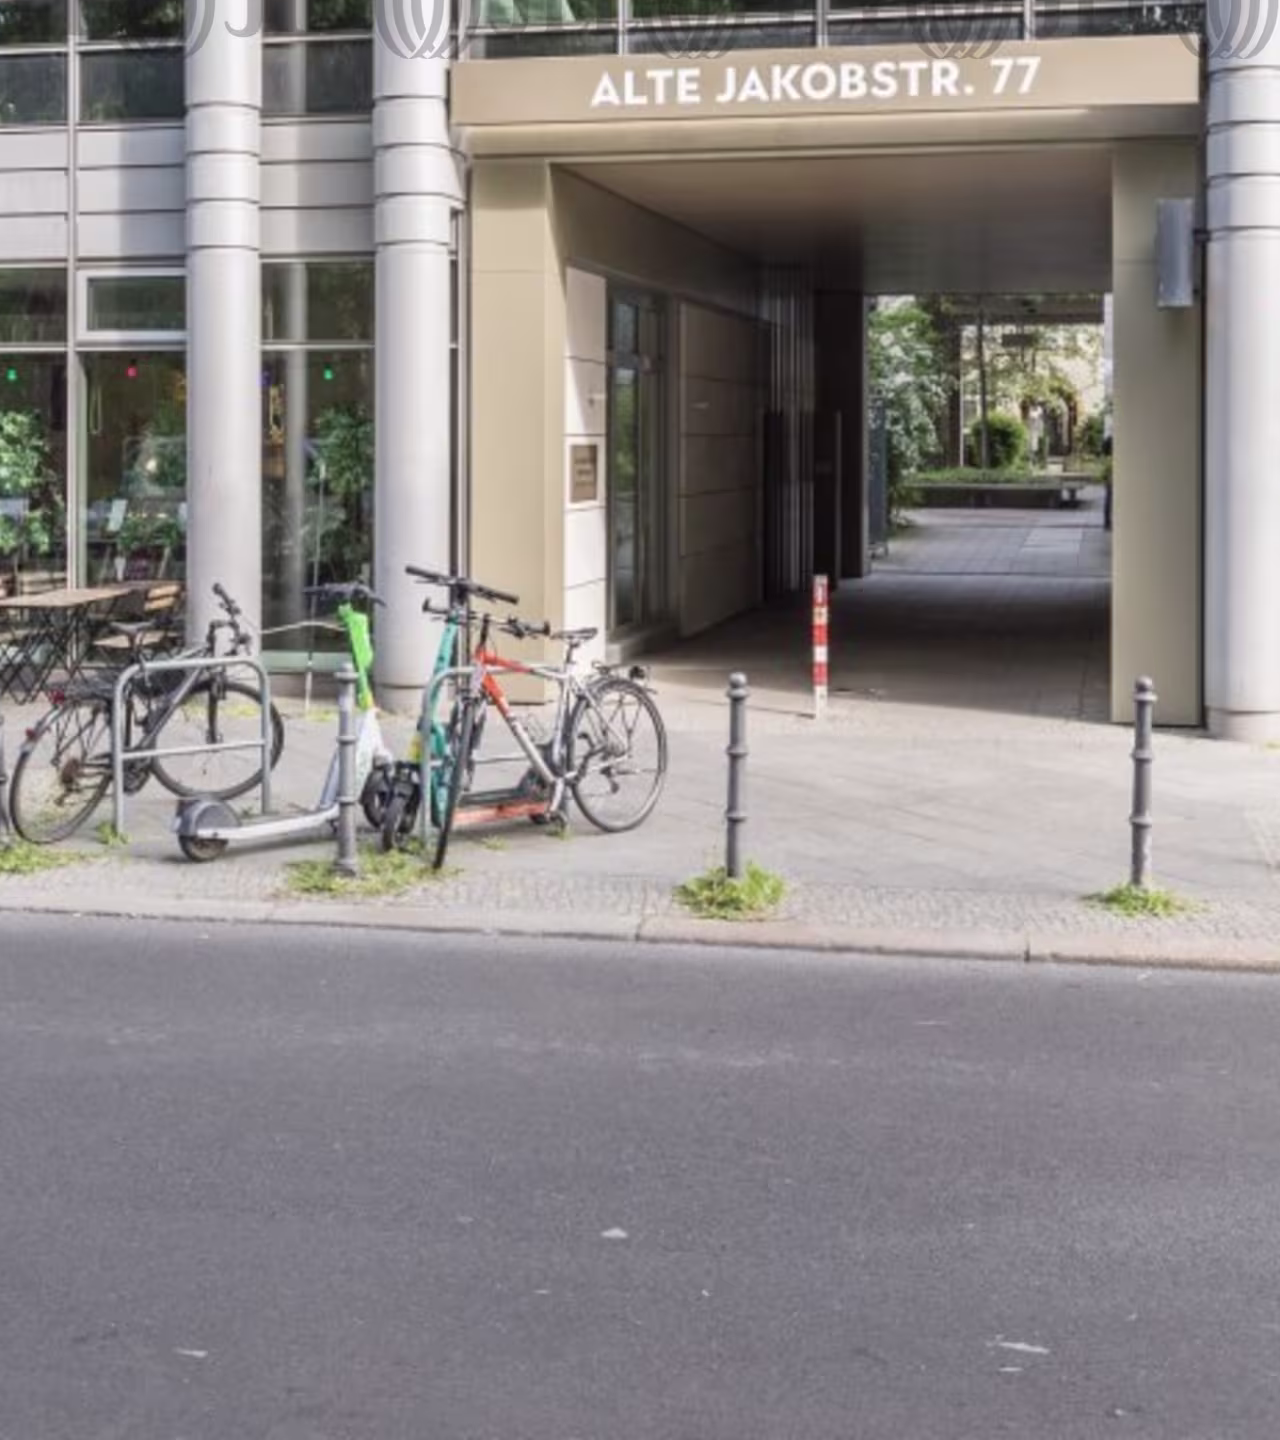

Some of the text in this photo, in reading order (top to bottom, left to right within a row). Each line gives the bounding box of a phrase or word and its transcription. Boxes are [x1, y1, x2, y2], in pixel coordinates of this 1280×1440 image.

[590, 56, 1041, 107] ALTE JAKOBSTR. 77
